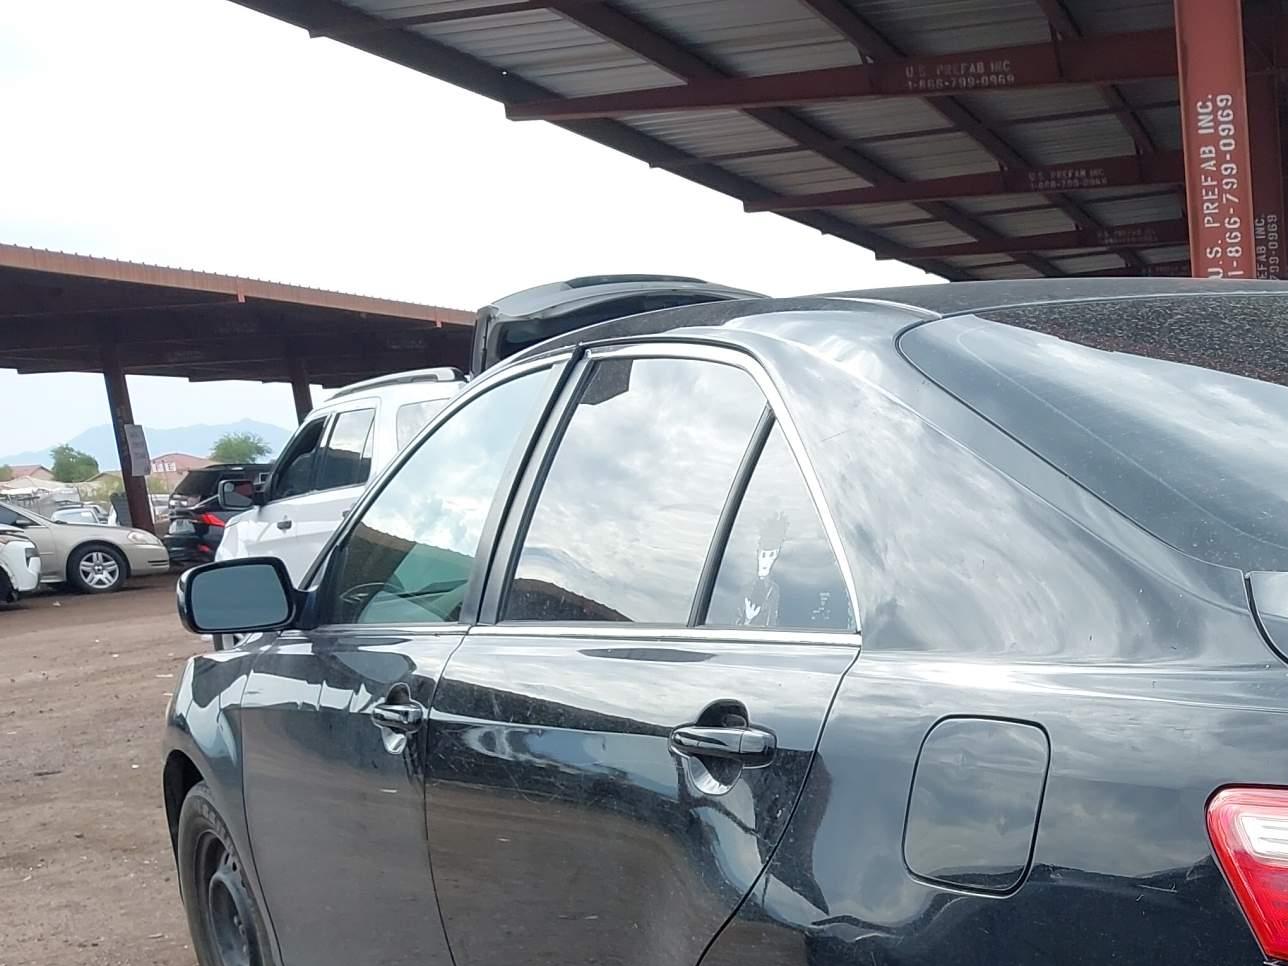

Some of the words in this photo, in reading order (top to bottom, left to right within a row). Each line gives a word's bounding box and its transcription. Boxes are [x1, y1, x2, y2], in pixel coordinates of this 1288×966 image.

[1196, 94, 1215, 135] INC.
[1200, 145, 1221, 228] PREFAB
[1216, 94, 1244, 277] 1-866-799-0969
[1207, 239, 1224, 279] U.S.
